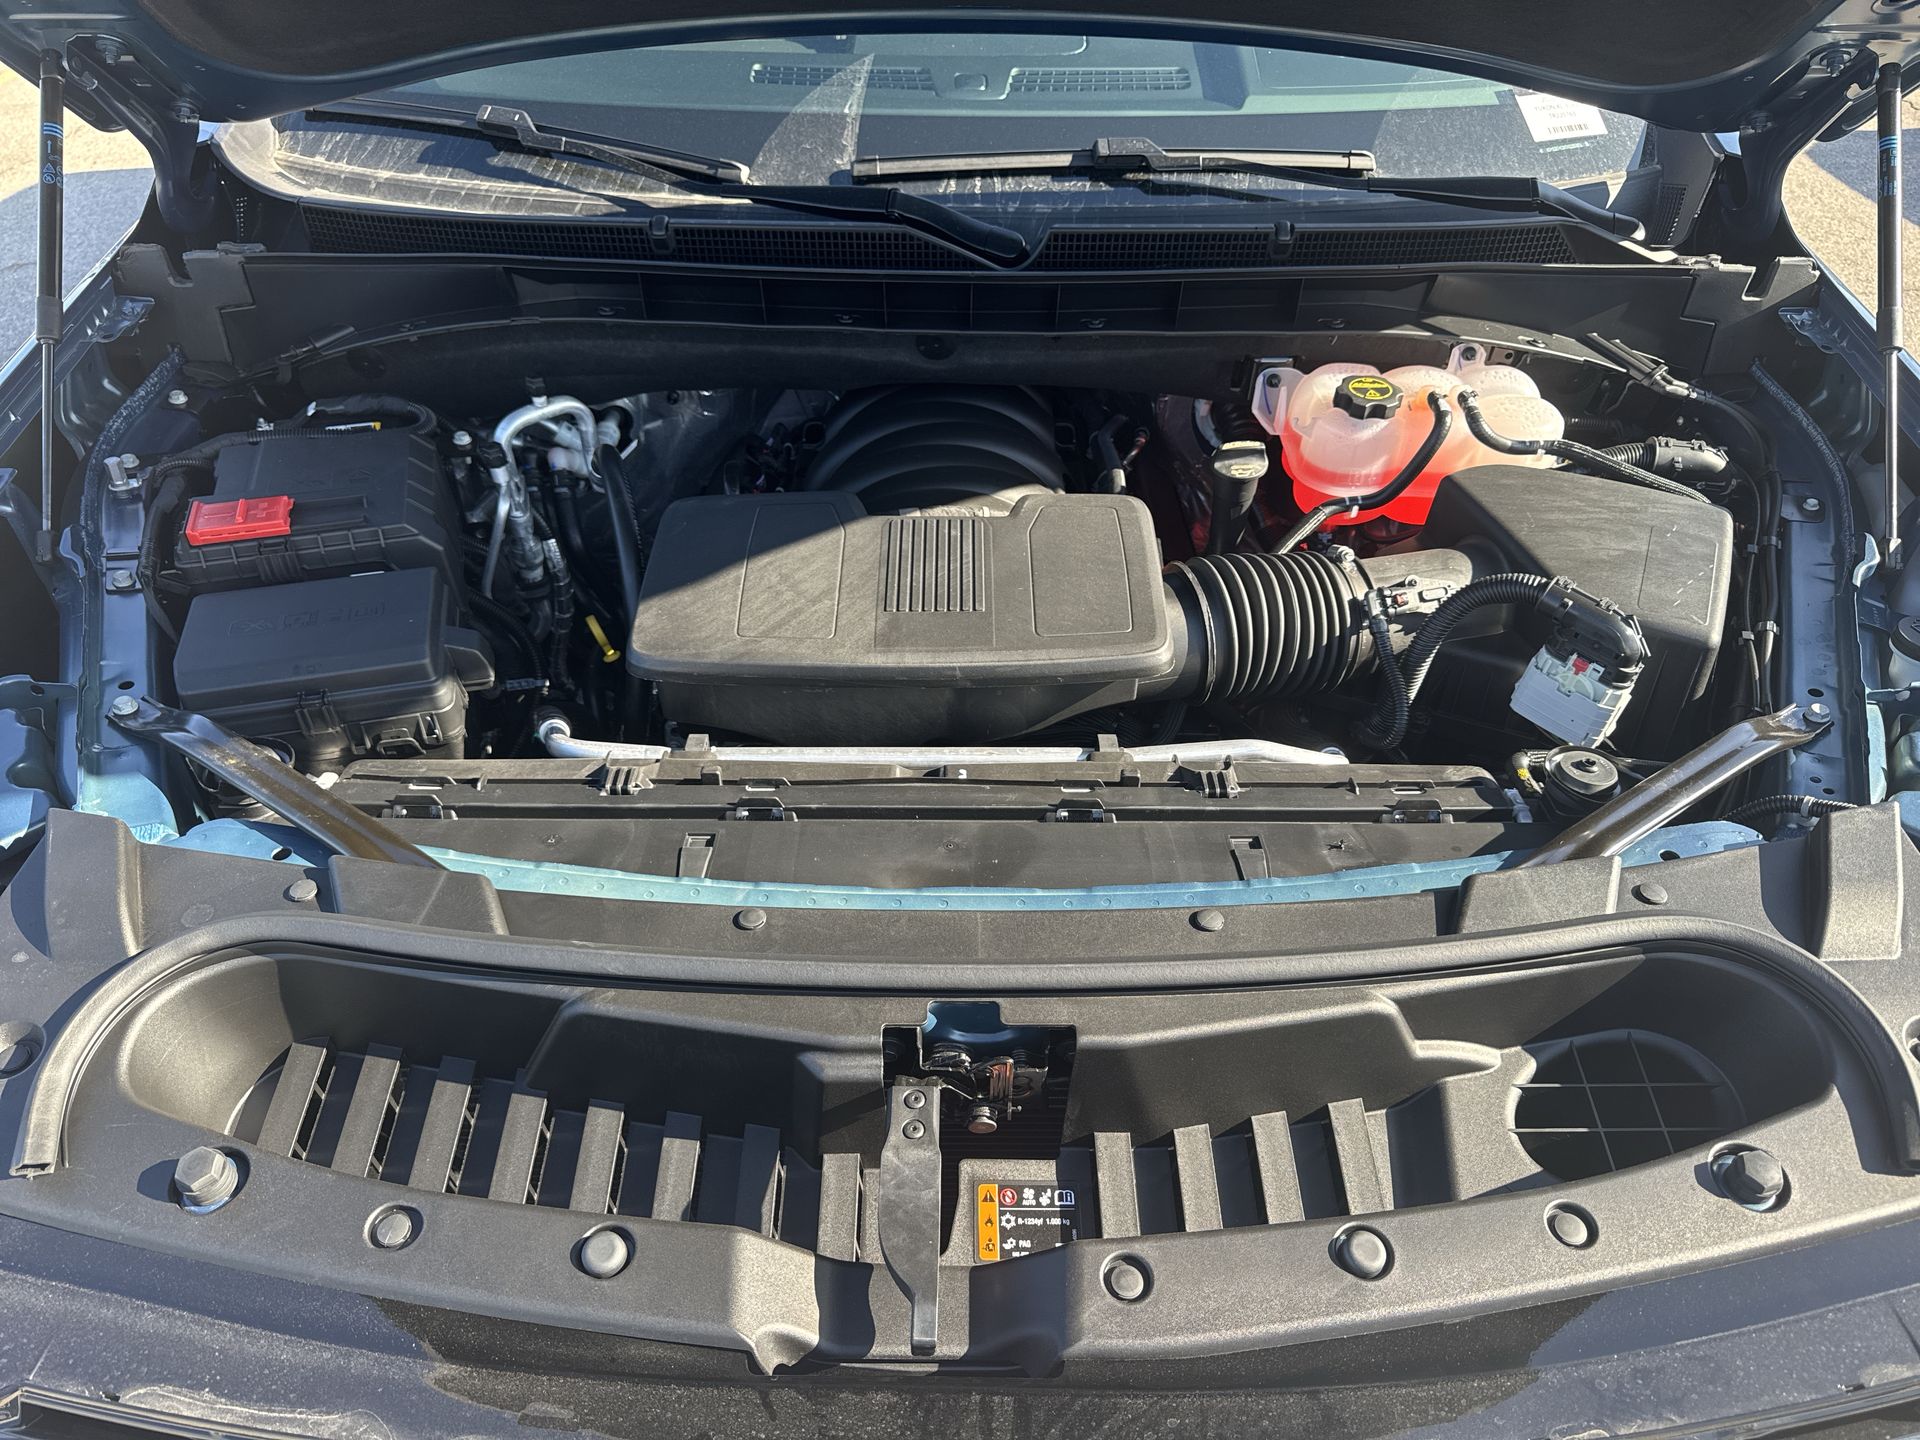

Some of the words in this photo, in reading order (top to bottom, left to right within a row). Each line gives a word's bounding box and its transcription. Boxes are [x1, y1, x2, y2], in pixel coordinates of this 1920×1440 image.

[1017, 1217, 1043, 1226] R-1234yf
[1063, 1218, 1070, 1226] kg
[1018, 1239, 1031, 1248] PAG
